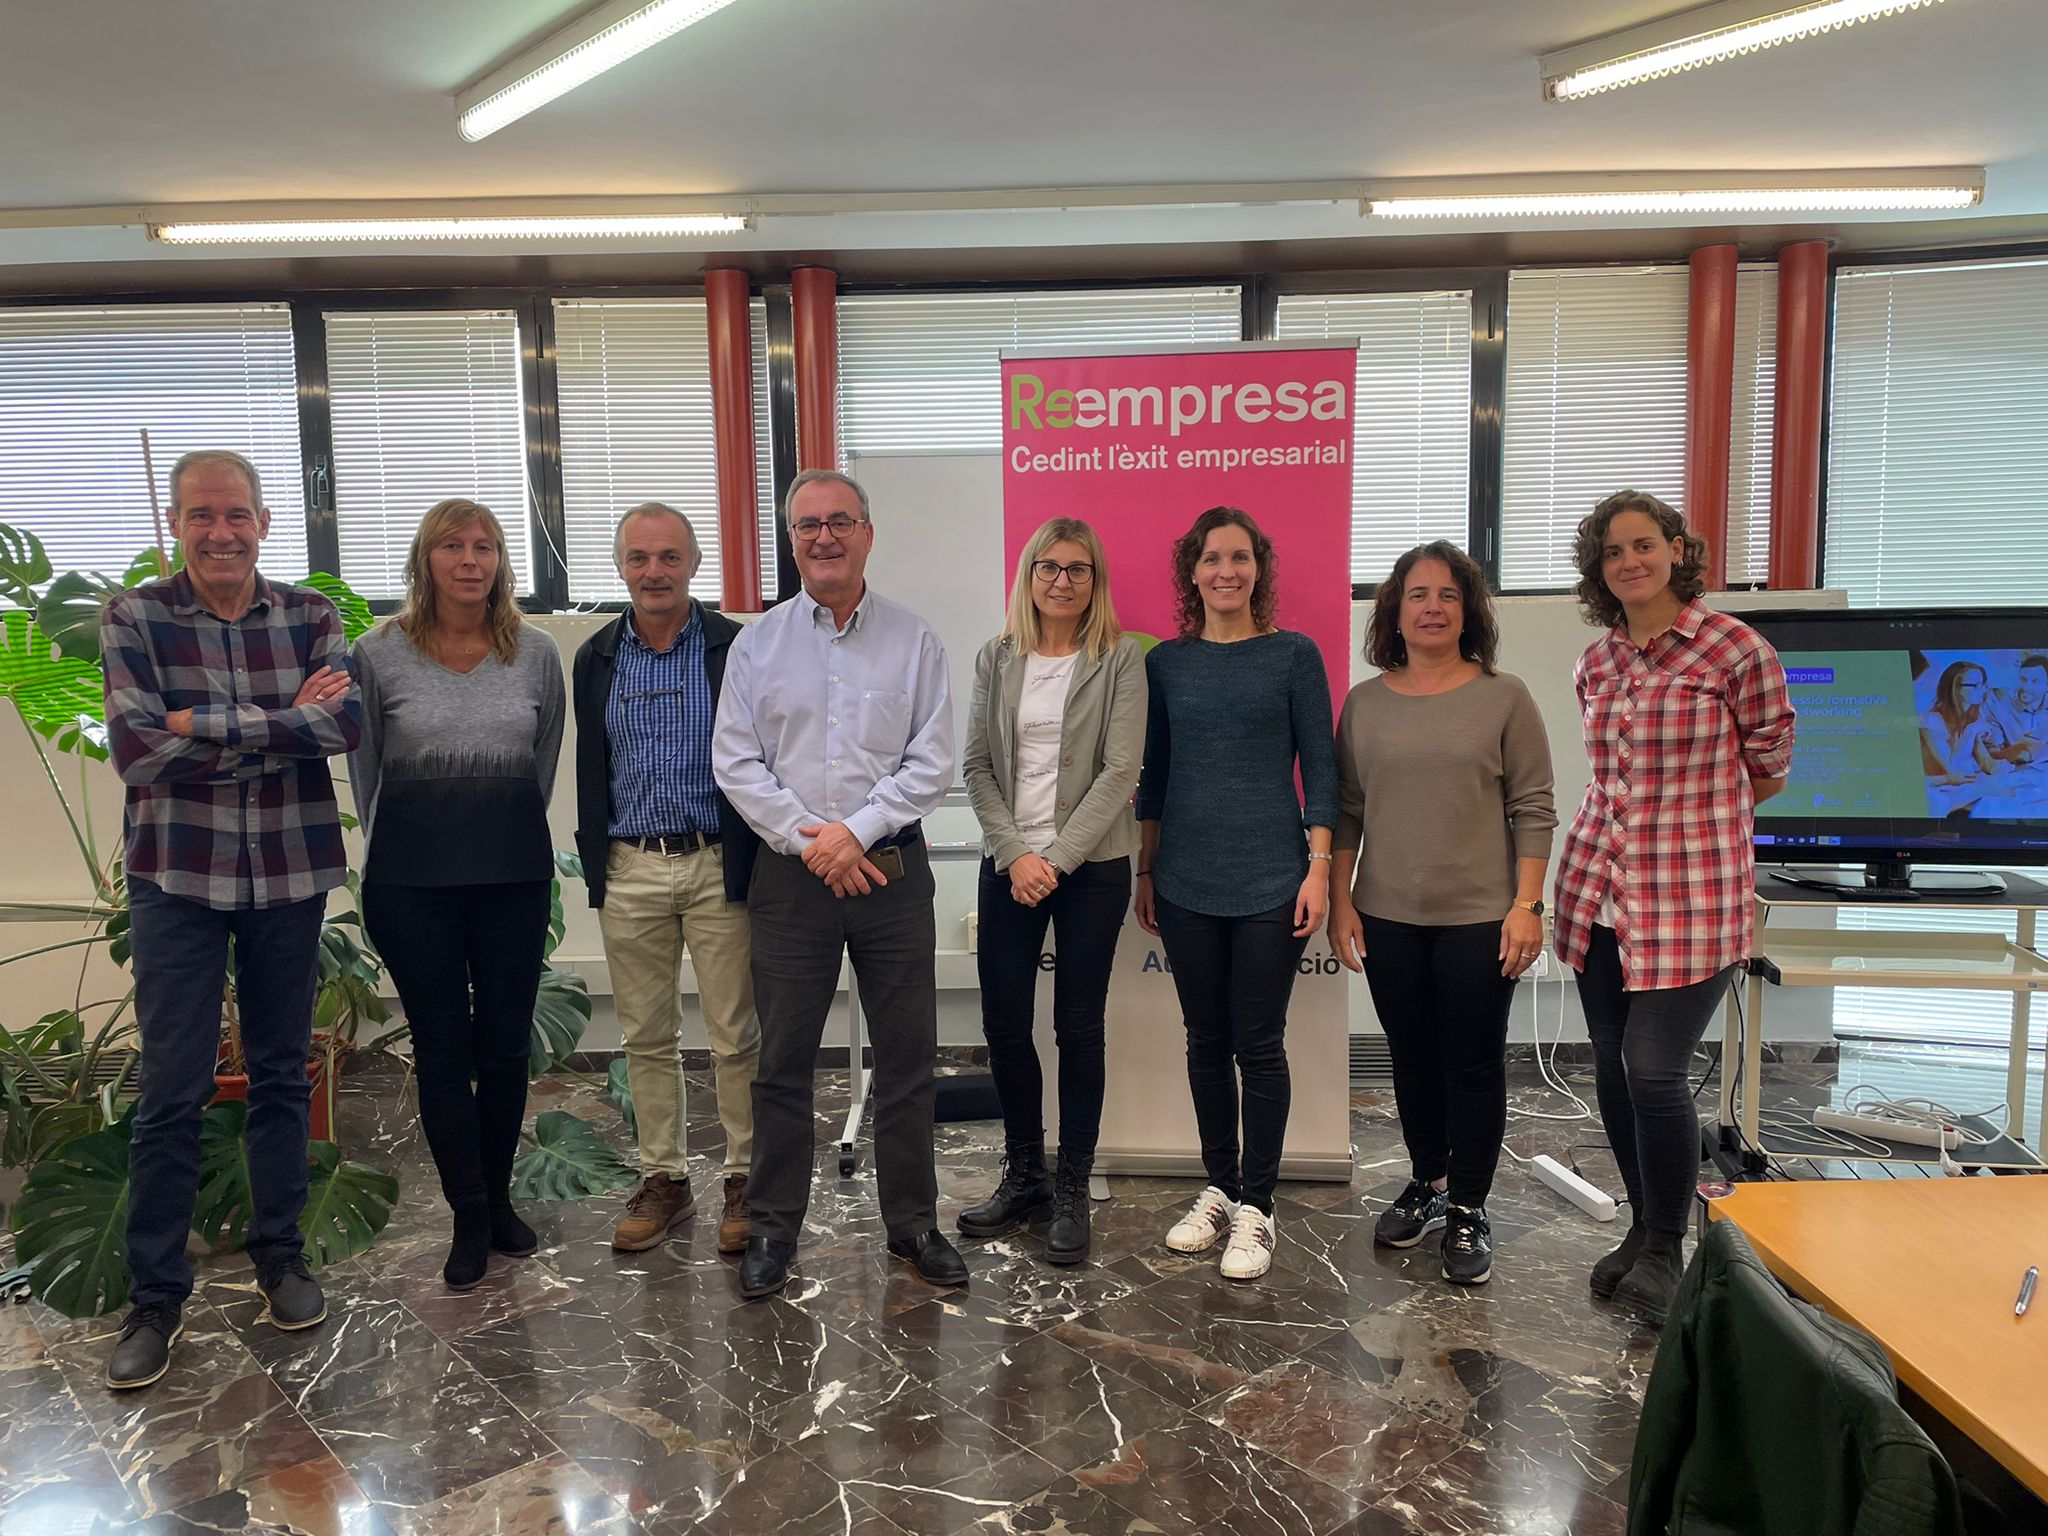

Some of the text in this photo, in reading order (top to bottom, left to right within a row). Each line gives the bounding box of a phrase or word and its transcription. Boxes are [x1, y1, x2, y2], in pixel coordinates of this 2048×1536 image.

[1010, 374, 1347, 437] Reempresa
[1011, 445, 1102, 473] Cedint
[1177, 439, 1346, 472] empresarial
